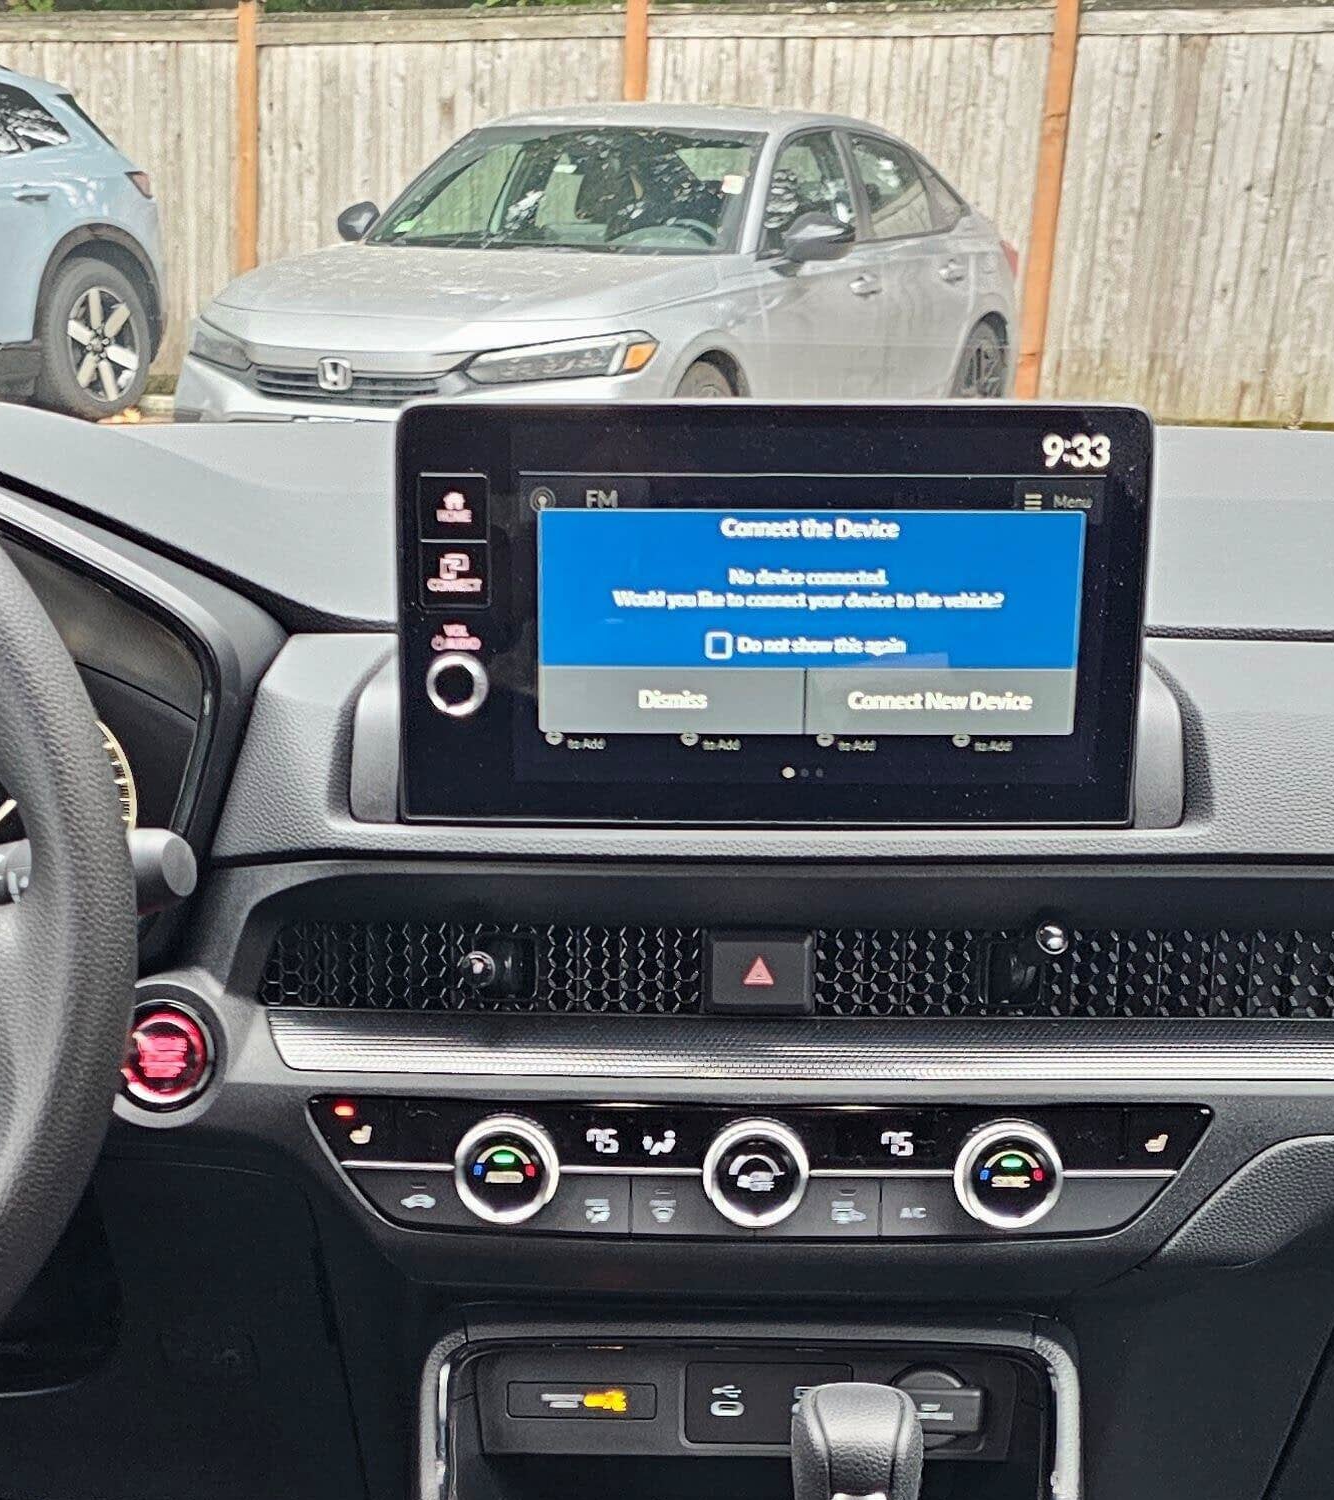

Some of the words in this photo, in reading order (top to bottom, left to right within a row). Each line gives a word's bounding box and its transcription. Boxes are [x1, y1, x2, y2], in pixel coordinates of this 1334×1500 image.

[1042, 433, 1111, 468] 9:33
[585, 489, 618, 508] FM
[1053, 494, 1093, 508] Menu
[720, 517, 799, 538] Connect
[801, 518, 833, 538] the
[835, 518, 900, 538] Device
[729, 568, 754, 585] No
[755, 568, 806, 585] device
[612, 590, 666, 608] Would
[667, 593, 696, 610] you
[697, 590, 725, 608] like
[726, 592, 744, 608] to
[896, 593, 915, 609] to
[915, 592, 943, 609] the
[736, 636, 762, 653] Do
[763, 637, 789, 653] not
[791, 637, 834, 653] show
[834, 637, 863, 653] this
[864, 637, 907, 656] again
[638, 689, 708, 709] Dismiss
[847, 691, 924, 710] Connect
[925, 691, 968, 710] New
[969, 691, 1033, 710] Device
